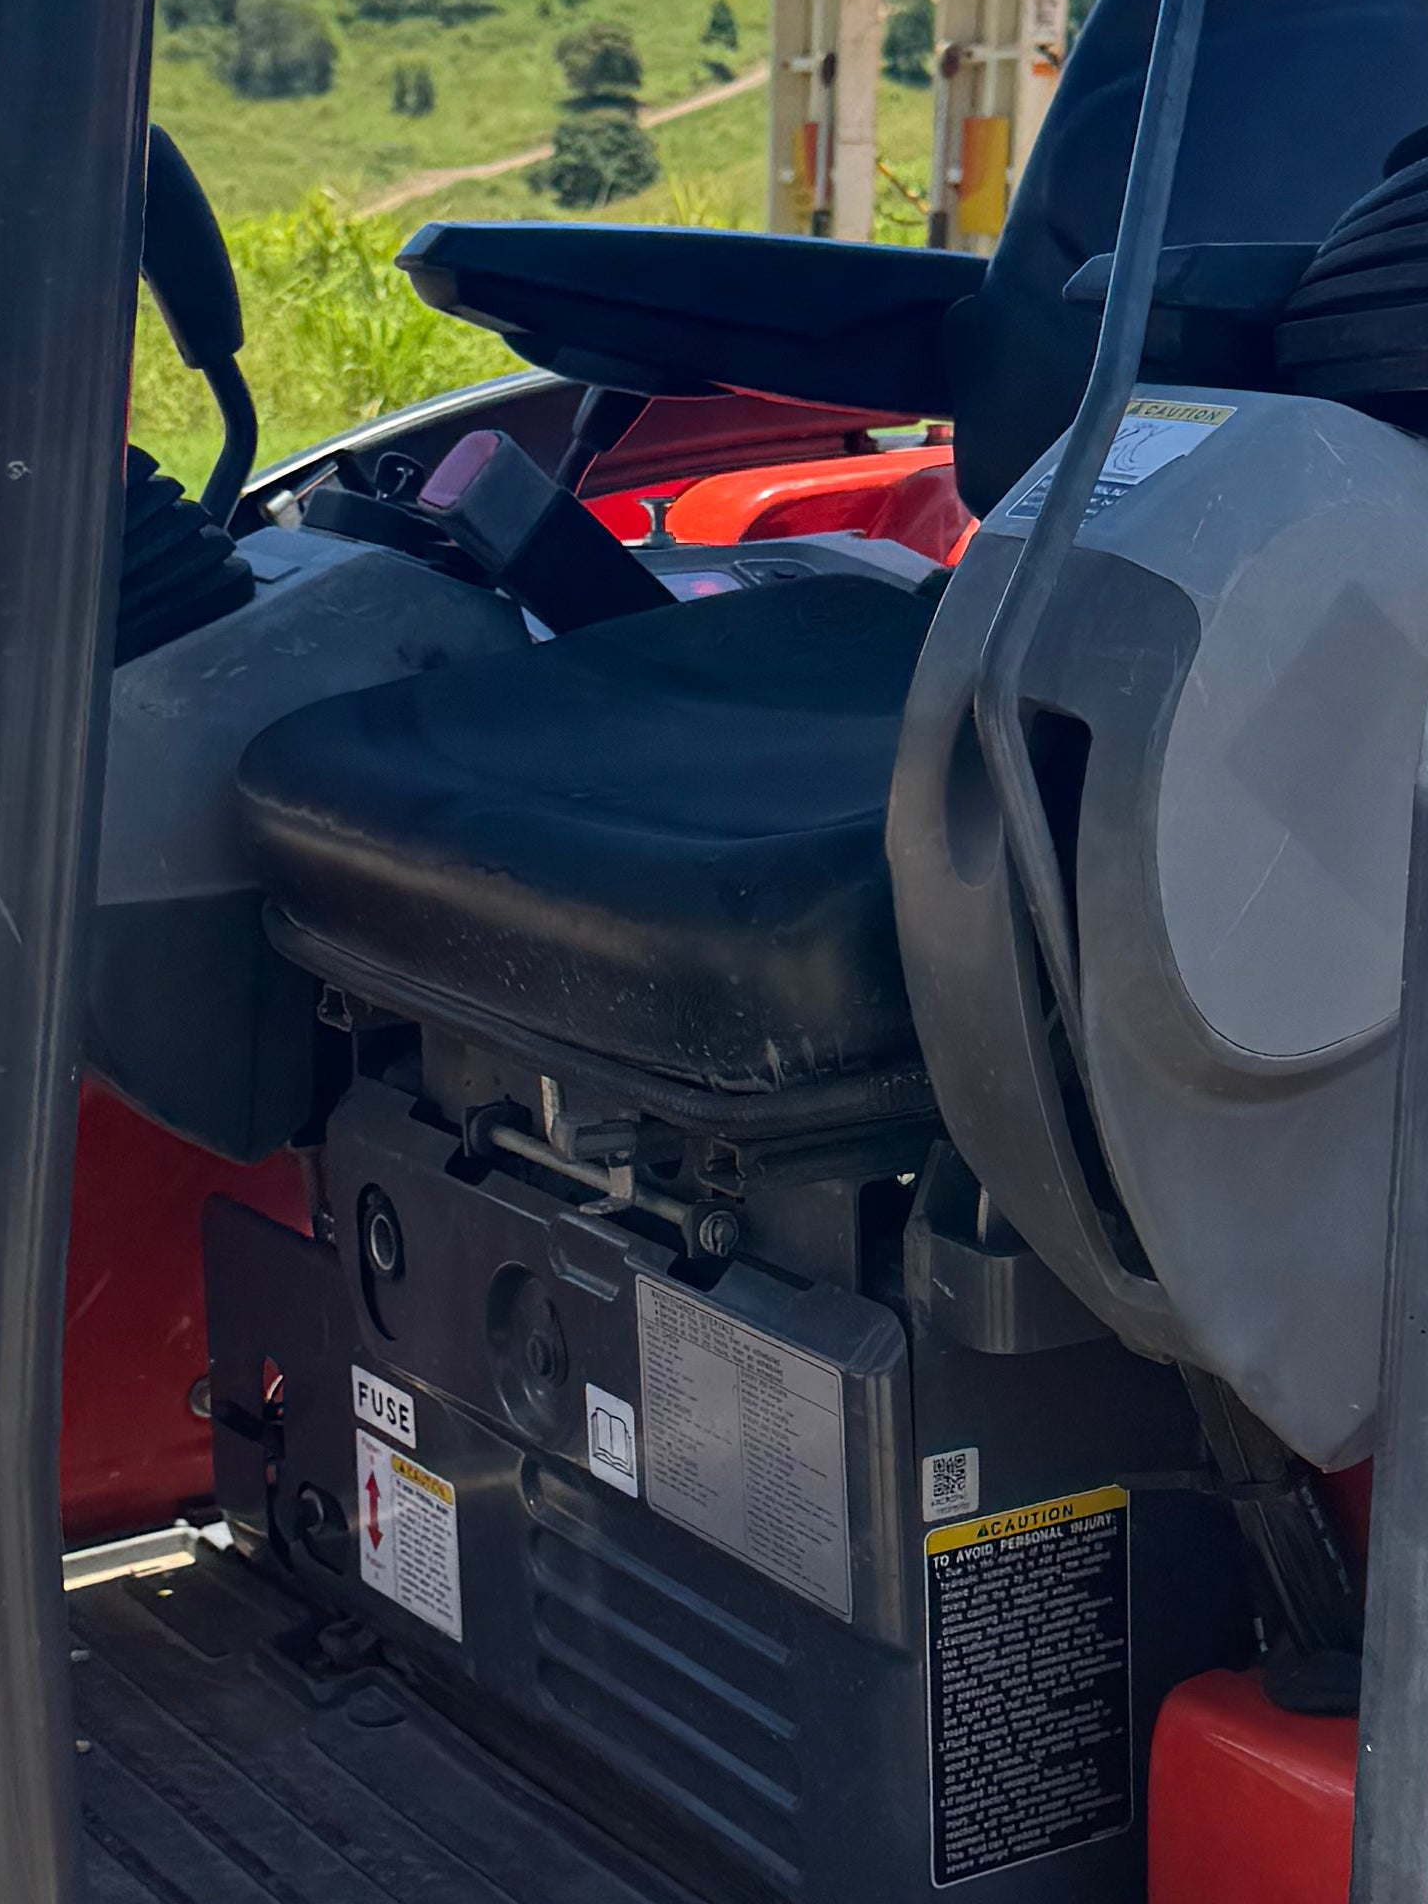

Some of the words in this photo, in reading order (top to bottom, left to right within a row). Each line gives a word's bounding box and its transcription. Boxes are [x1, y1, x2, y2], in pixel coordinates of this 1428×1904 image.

[1144, 404, 1224, 422] CAUTION
[357, 1380, 411, 1434] FUSE
[991, 1503, 1073, 1535] CAUTION
[933, 1554, 949, 1570] TO
[955, 1541, 993, 1563] AVOID
[999, 1524, 1063, 1552] PERSONAL
